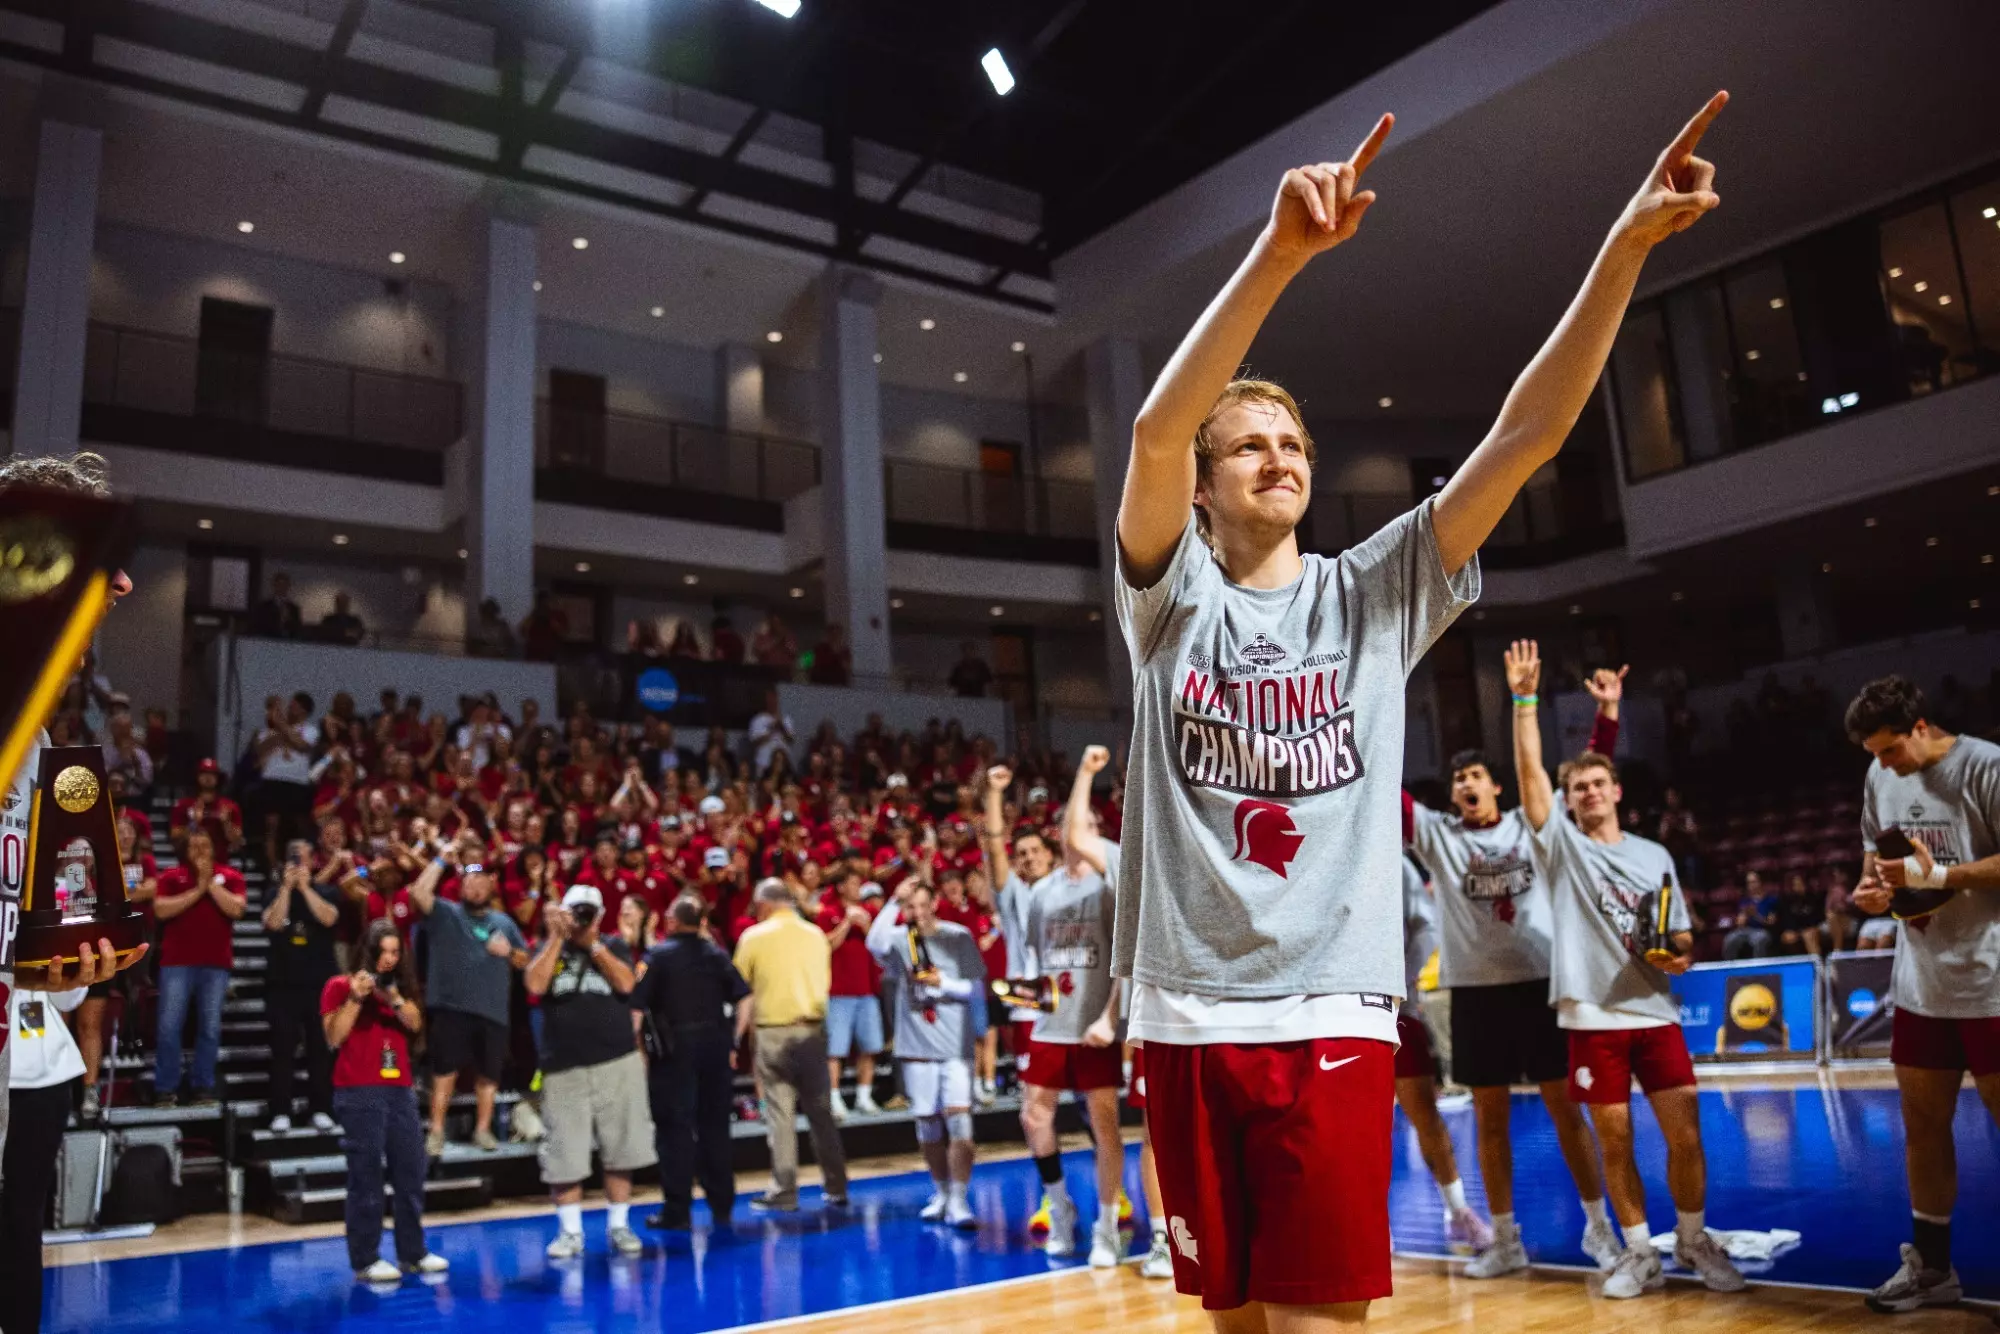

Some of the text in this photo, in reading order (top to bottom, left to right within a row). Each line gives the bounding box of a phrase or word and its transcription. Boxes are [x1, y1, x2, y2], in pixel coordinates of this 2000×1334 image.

[1186, 653, 1211, 669] 2025
[1301, 649, 1348, 669] VOLLEYBALL
[1181, 668, 1350, 737] NATIONAL
[1180, 718, 1356, 791] CHAMPIONS
